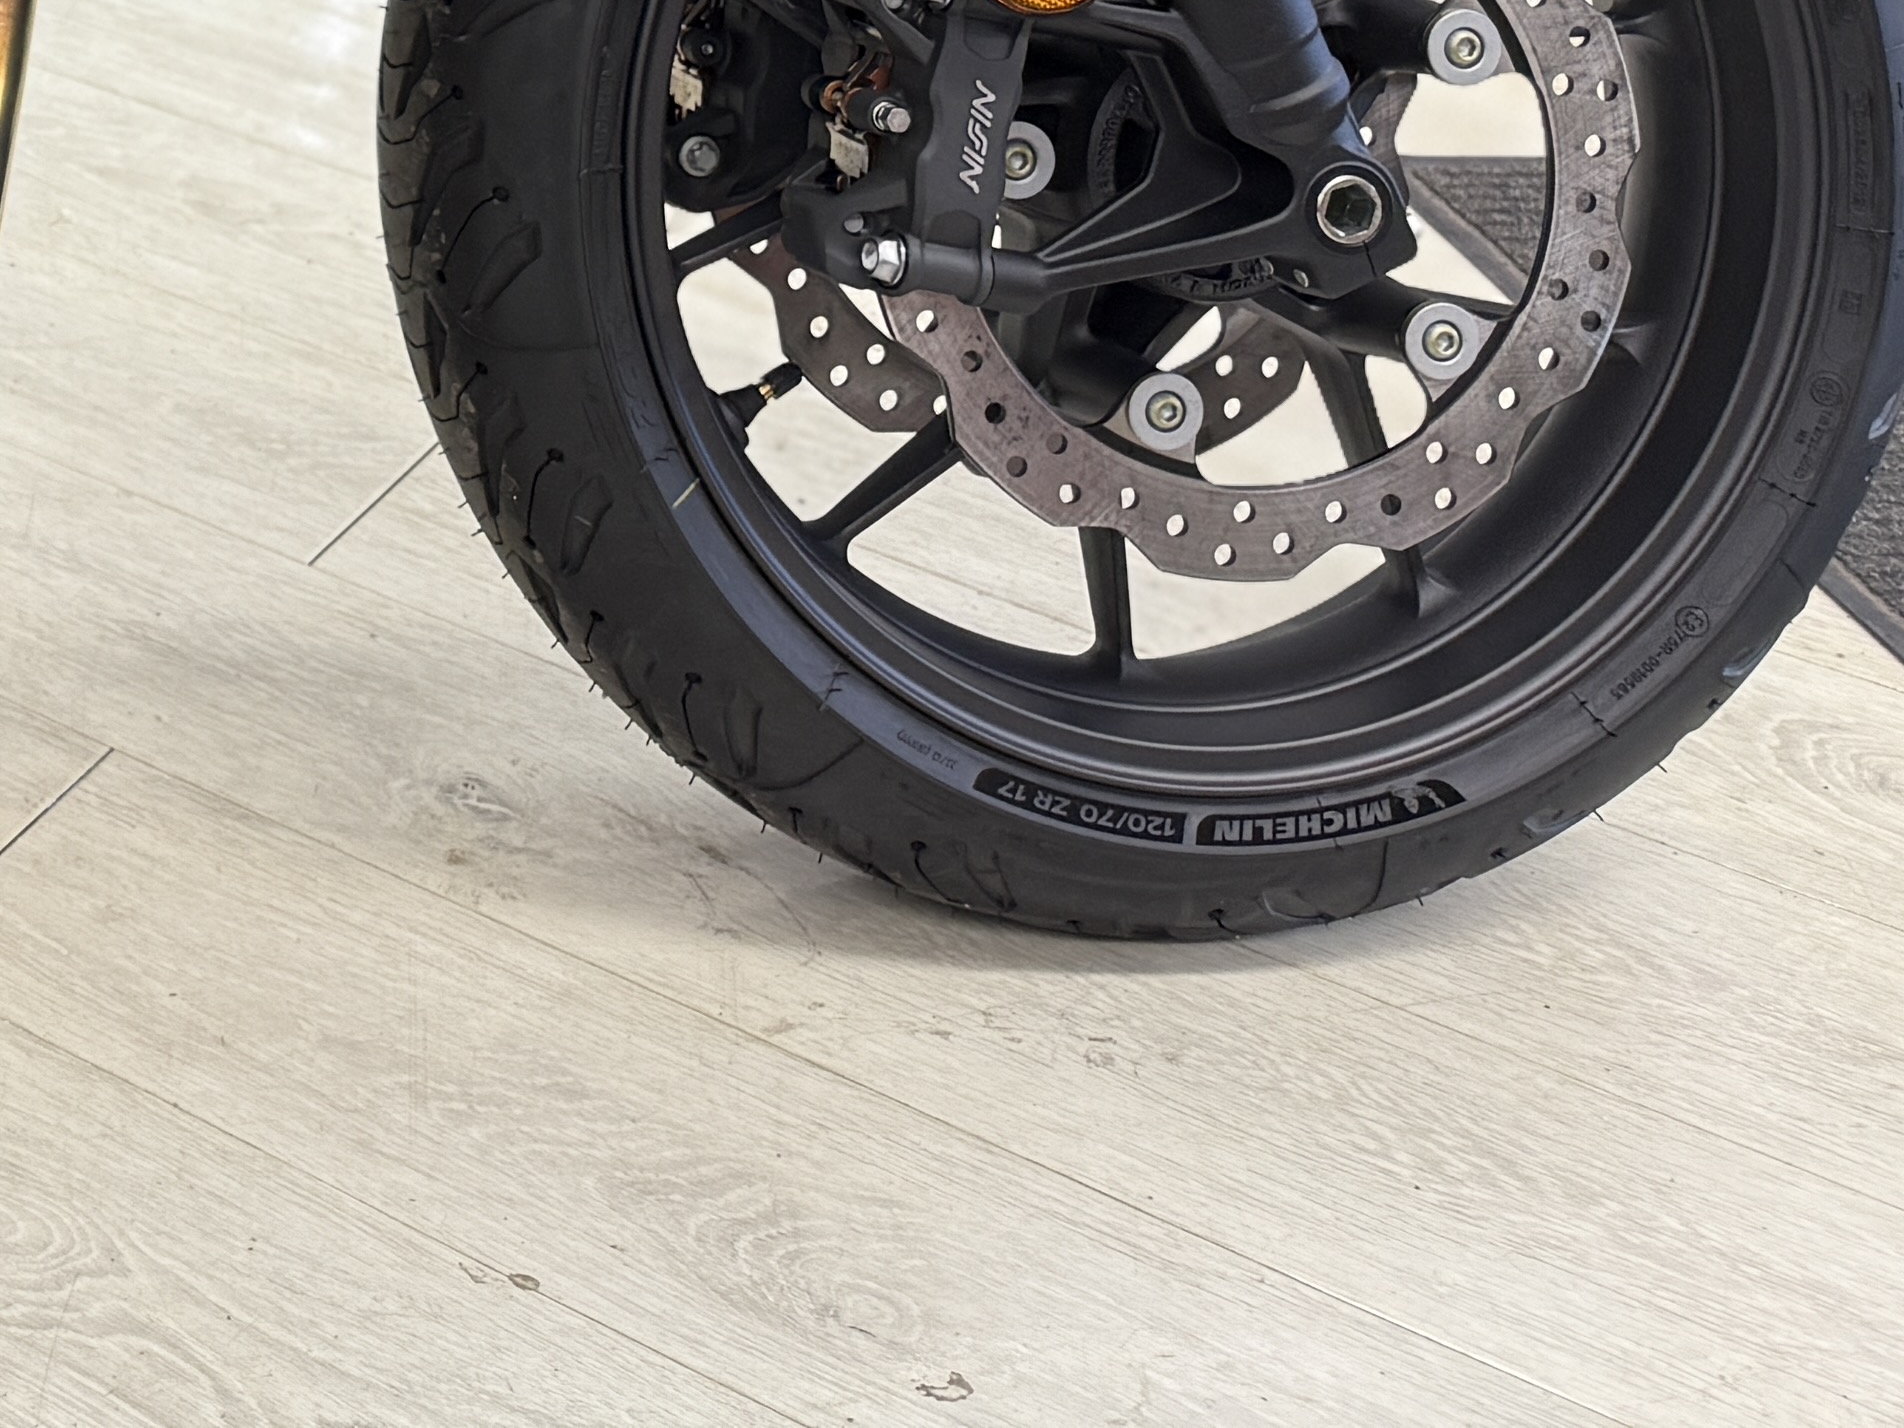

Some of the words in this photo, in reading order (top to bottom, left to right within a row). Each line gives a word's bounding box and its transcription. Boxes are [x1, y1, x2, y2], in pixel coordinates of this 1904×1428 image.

[997, 779, 1027, 803] 17
[1033, 787, 1069, 818] ZR
[1080, 802, 1176, 838] 120/70
[1213, 798, 1392, 843] MICHELIN
